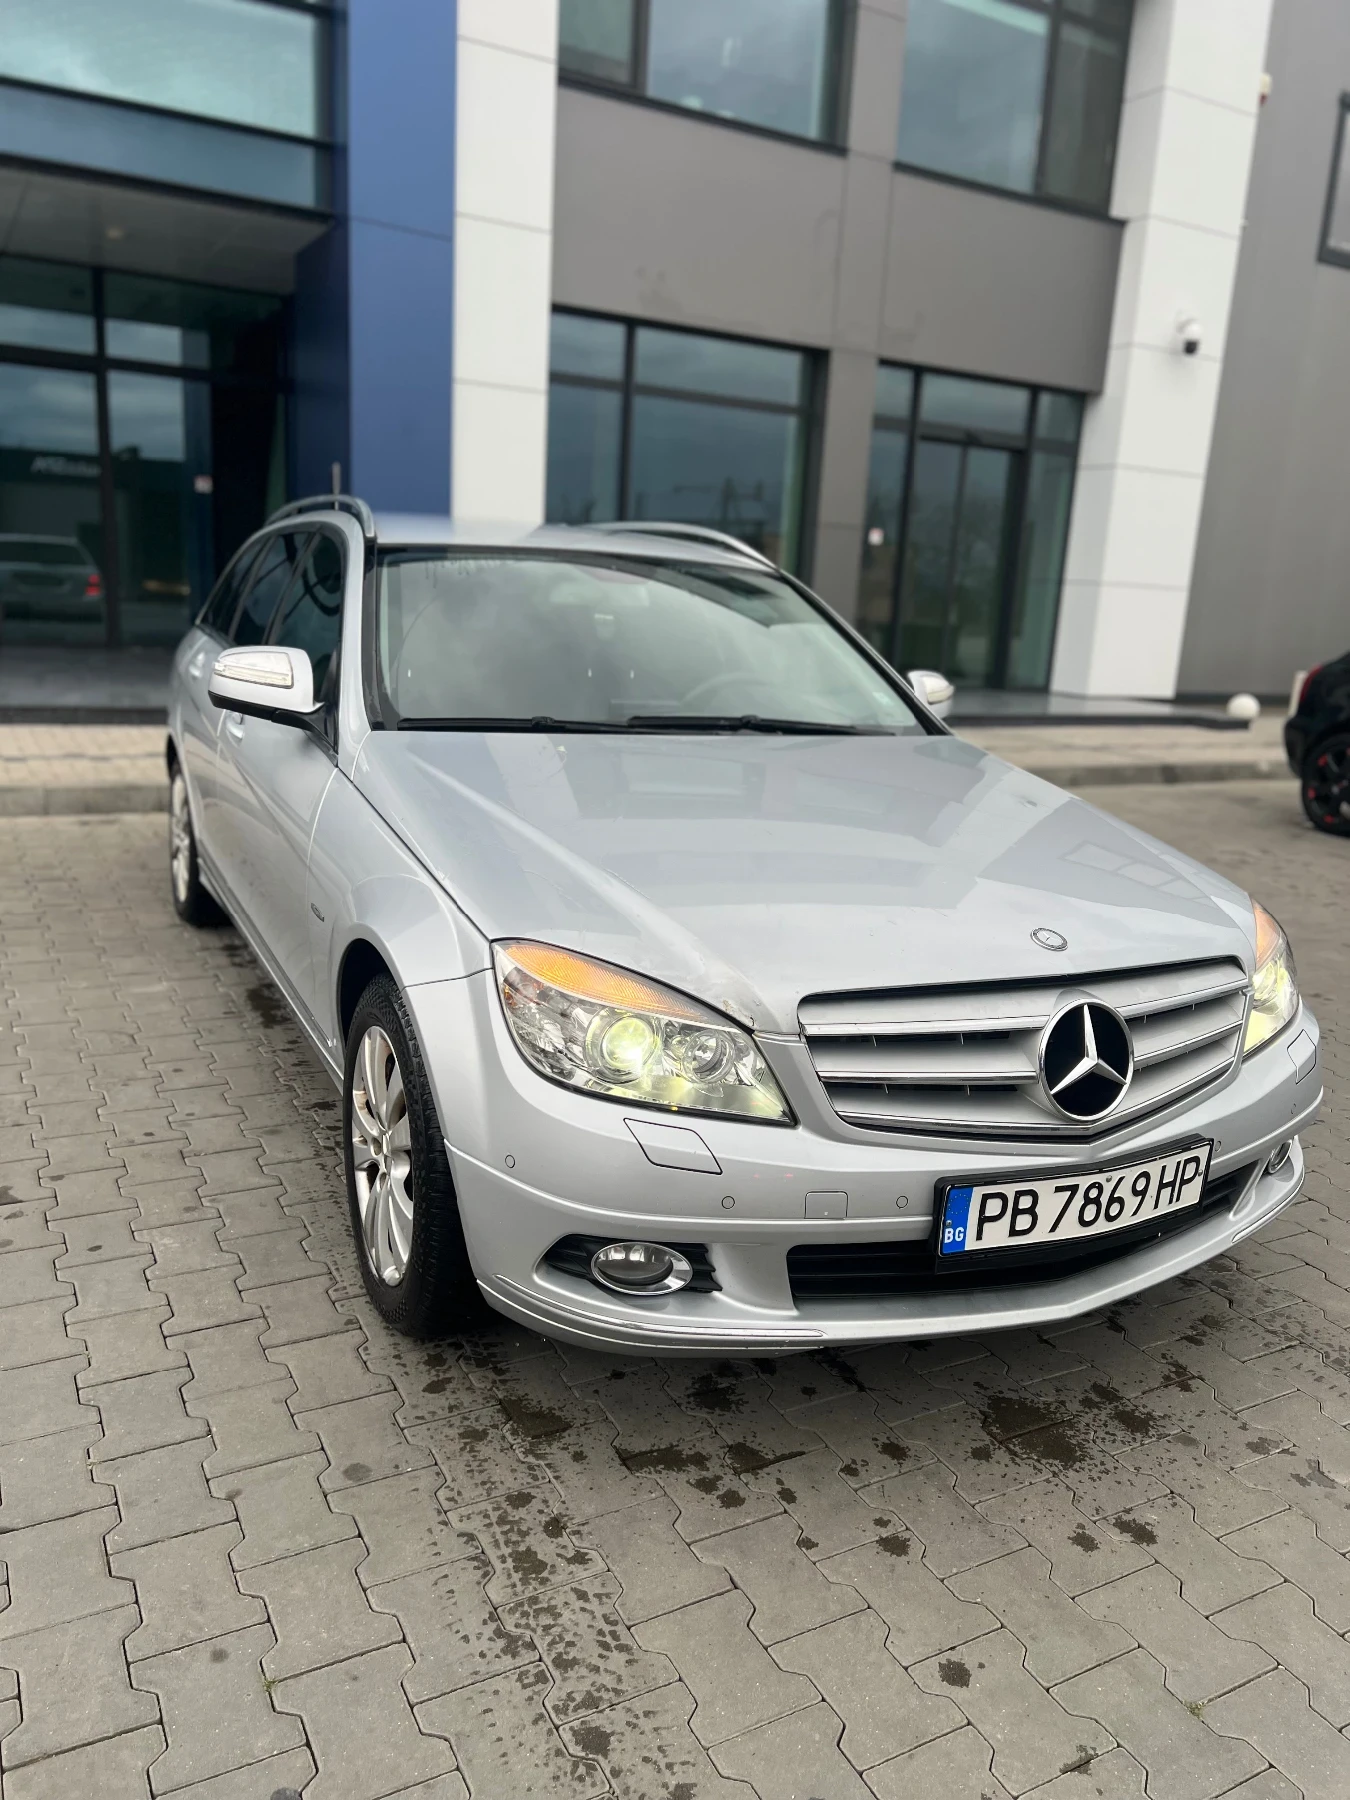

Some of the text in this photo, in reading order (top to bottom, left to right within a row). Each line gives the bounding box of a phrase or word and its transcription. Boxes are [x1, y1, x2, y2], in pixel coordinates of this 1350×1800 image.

[976, 1155, 1200, 1241] PB 7869 HP
[944, 1226, 964, 1243] BG
